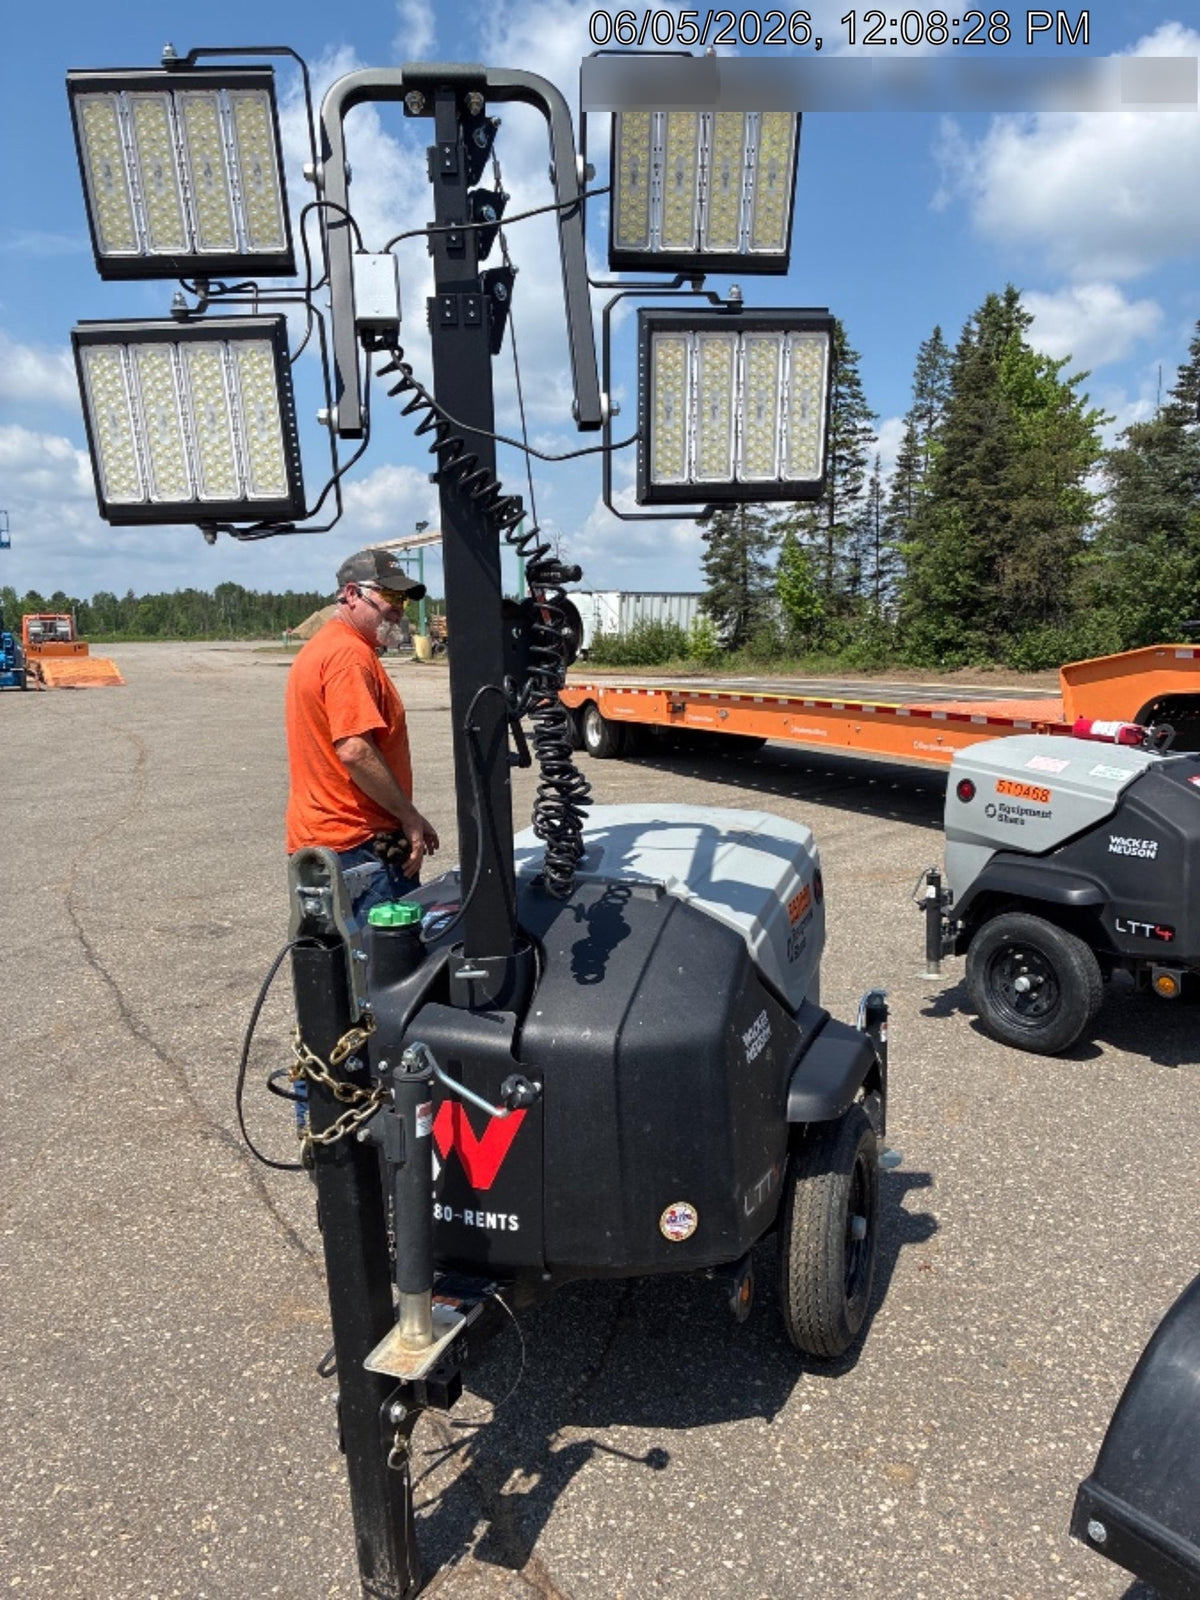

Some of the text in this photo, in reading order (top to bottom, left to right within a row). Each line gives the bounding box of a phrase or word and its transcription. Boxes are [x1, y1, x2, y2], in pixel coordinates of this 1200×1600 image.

[1109, 835, 1158, 850] WACKER
[1108, 843, 1157, 859] NEUSON
[1115, 918, 1172, 941] LTT4
